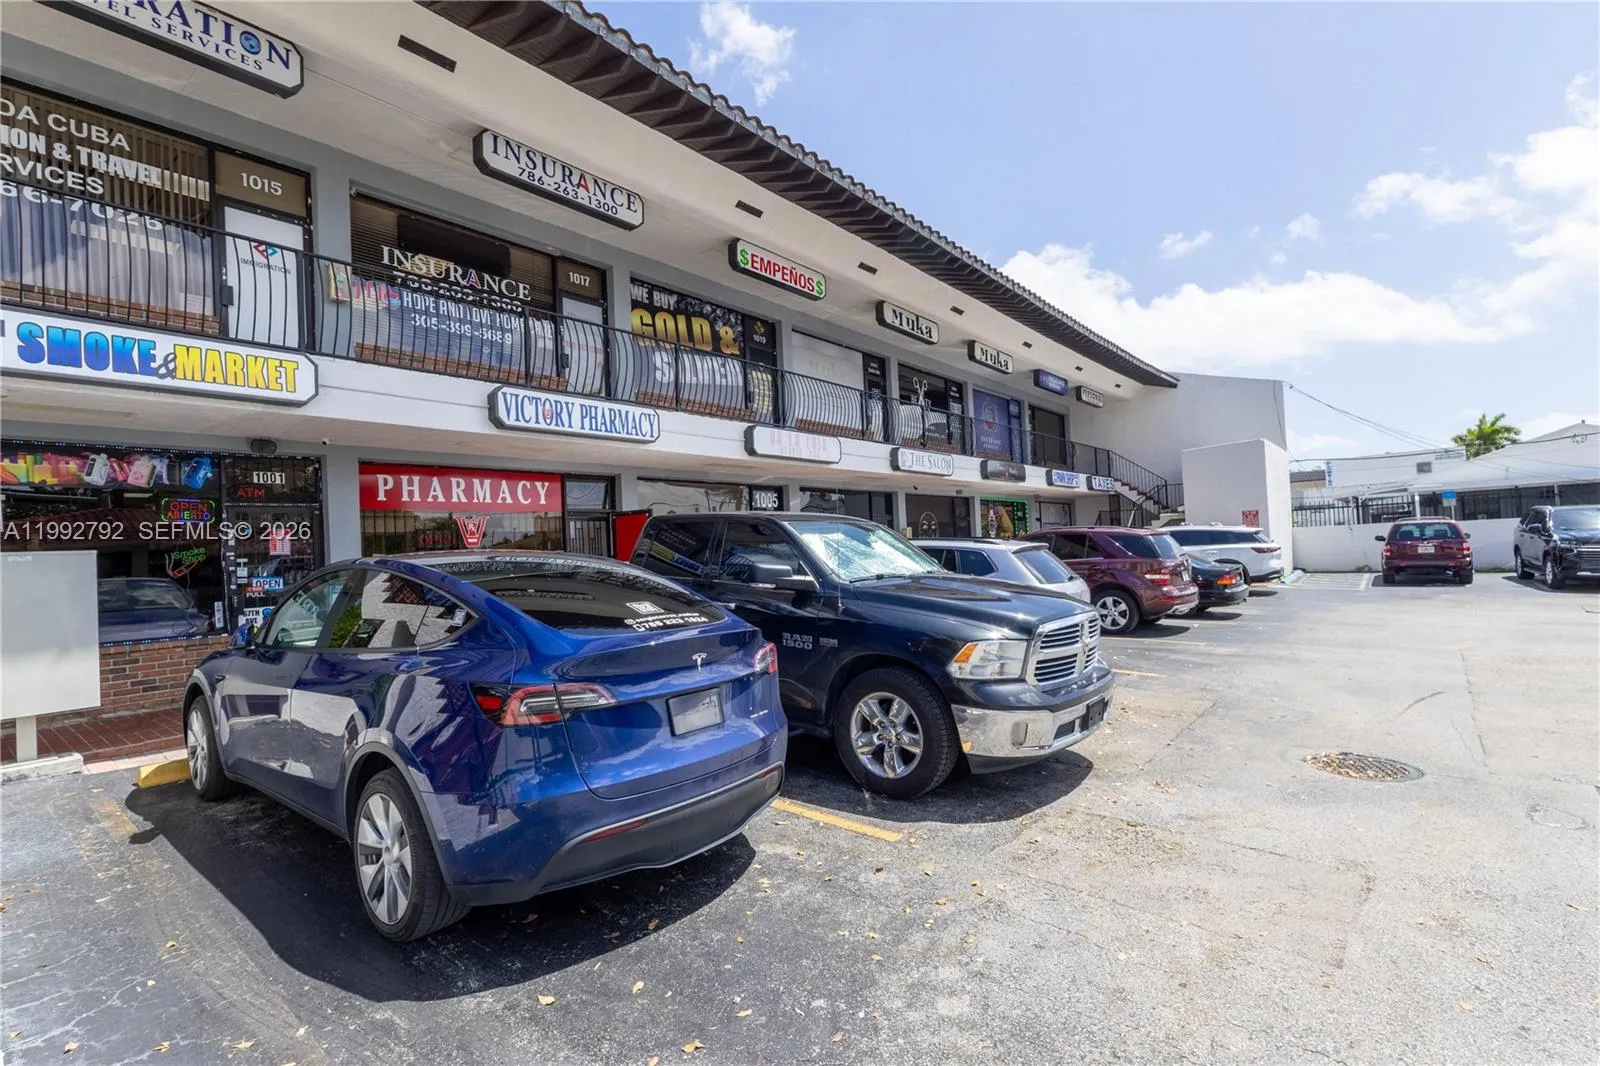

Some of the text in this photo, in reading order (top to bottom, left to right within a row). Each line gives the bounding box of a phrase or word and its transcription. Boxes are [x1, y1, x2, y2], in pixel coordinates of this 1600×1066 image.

[151, 16, 263, 71] SERVICES
[47, 113, 131, 152] CUBA
[52, 141, 72, 164] &
[76, 143, 163, 190] TRAVEL
[491, 132, 638, 214] INSURANCE
[240, 171, 283, 196] 1015
[517, 165, 618, 217] 786-263-1300
[380, 244, 532, 300] INSURANCE
[568, 271, 591, 287] 1017
[629, 282, 678, 311] WE BUY
[631, 307, 713, 352] GOLD
[892, 308, 933, 339] Muka
[16, 321, 157, 376] SMOKE
[174, 343, 299, 394] MARKET
[980, 347, 1010, 371] Muka
[501, 392, 657, 439] VICTORY PHARMACY
[255, 472, 284, 483] 1001
[377, 474, 550, 505] PHARMACY
[167, 510, 210, 520] ABIERTO
[170, 501, 208, 513] OPEN
[755, 491, 779, 508] 1005
[255, 580, 281, 588] OPEN
[783, 640, 813, 650] 1500
